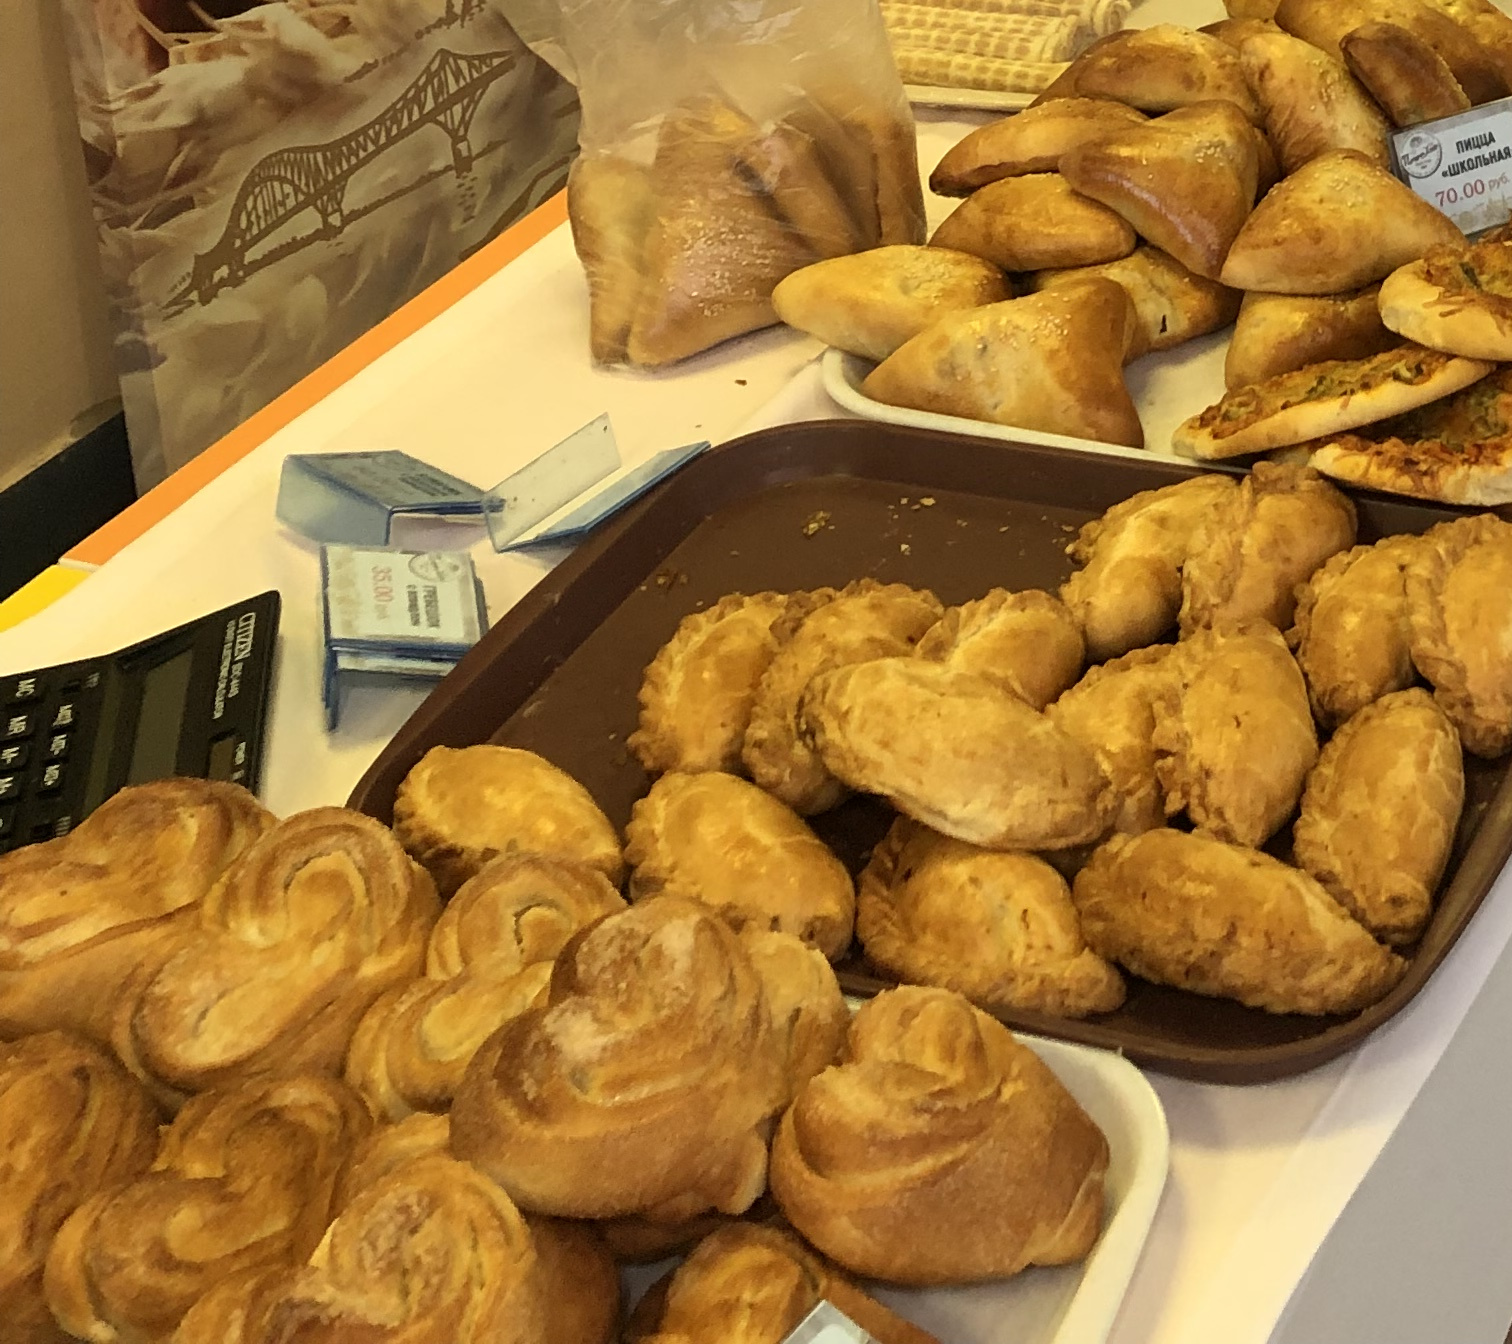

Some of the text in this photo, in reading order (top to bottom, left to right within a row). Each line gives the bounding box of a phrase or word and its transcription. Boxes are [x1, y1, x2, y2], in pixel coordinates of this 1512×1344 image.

[1456, 131, 1496, 155] ПИЦЦА
[1435, 178, 1486, 207] 70.00
[234, 612, 256, 662] CITIZEN
[16, 677, 37, 699] MC
[8, 714, 28, 736] MR
